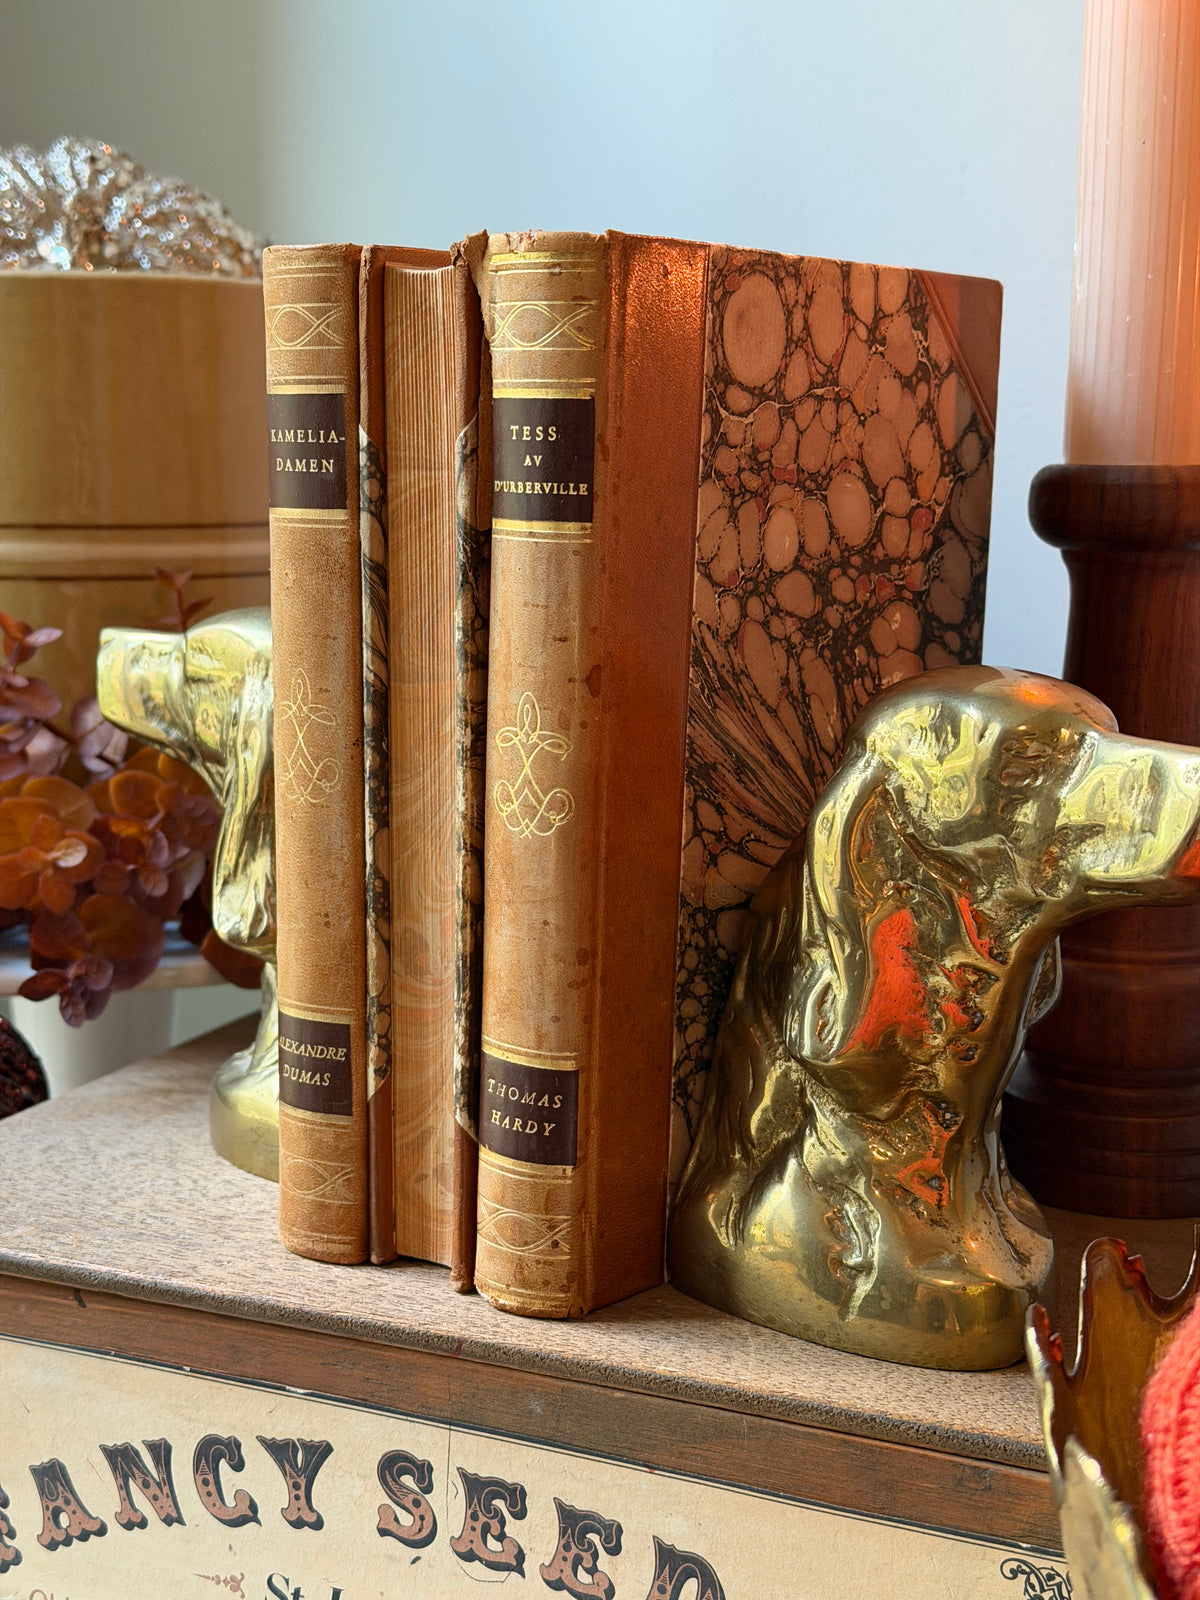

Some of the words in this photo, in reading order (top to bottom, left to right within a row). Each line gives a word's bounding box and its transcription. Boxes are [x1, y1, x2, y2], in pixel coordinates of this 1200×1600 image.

[270, 429, 346, 443] KAMELIA-
[509, 425, 557, 441] TESS
[276, 457, 334, 473] DAMEN
[523, 454, 543, 467] AV
[494, 480, 589, 496] D'URBERVILLE
[282, 1063, 331, 1086] DUMAS
[487, 1078, 563, 1109] THOMAS
[490, 1109, 556, 1137] HARDY
[0, 1434, 335, 1574] ANCY
